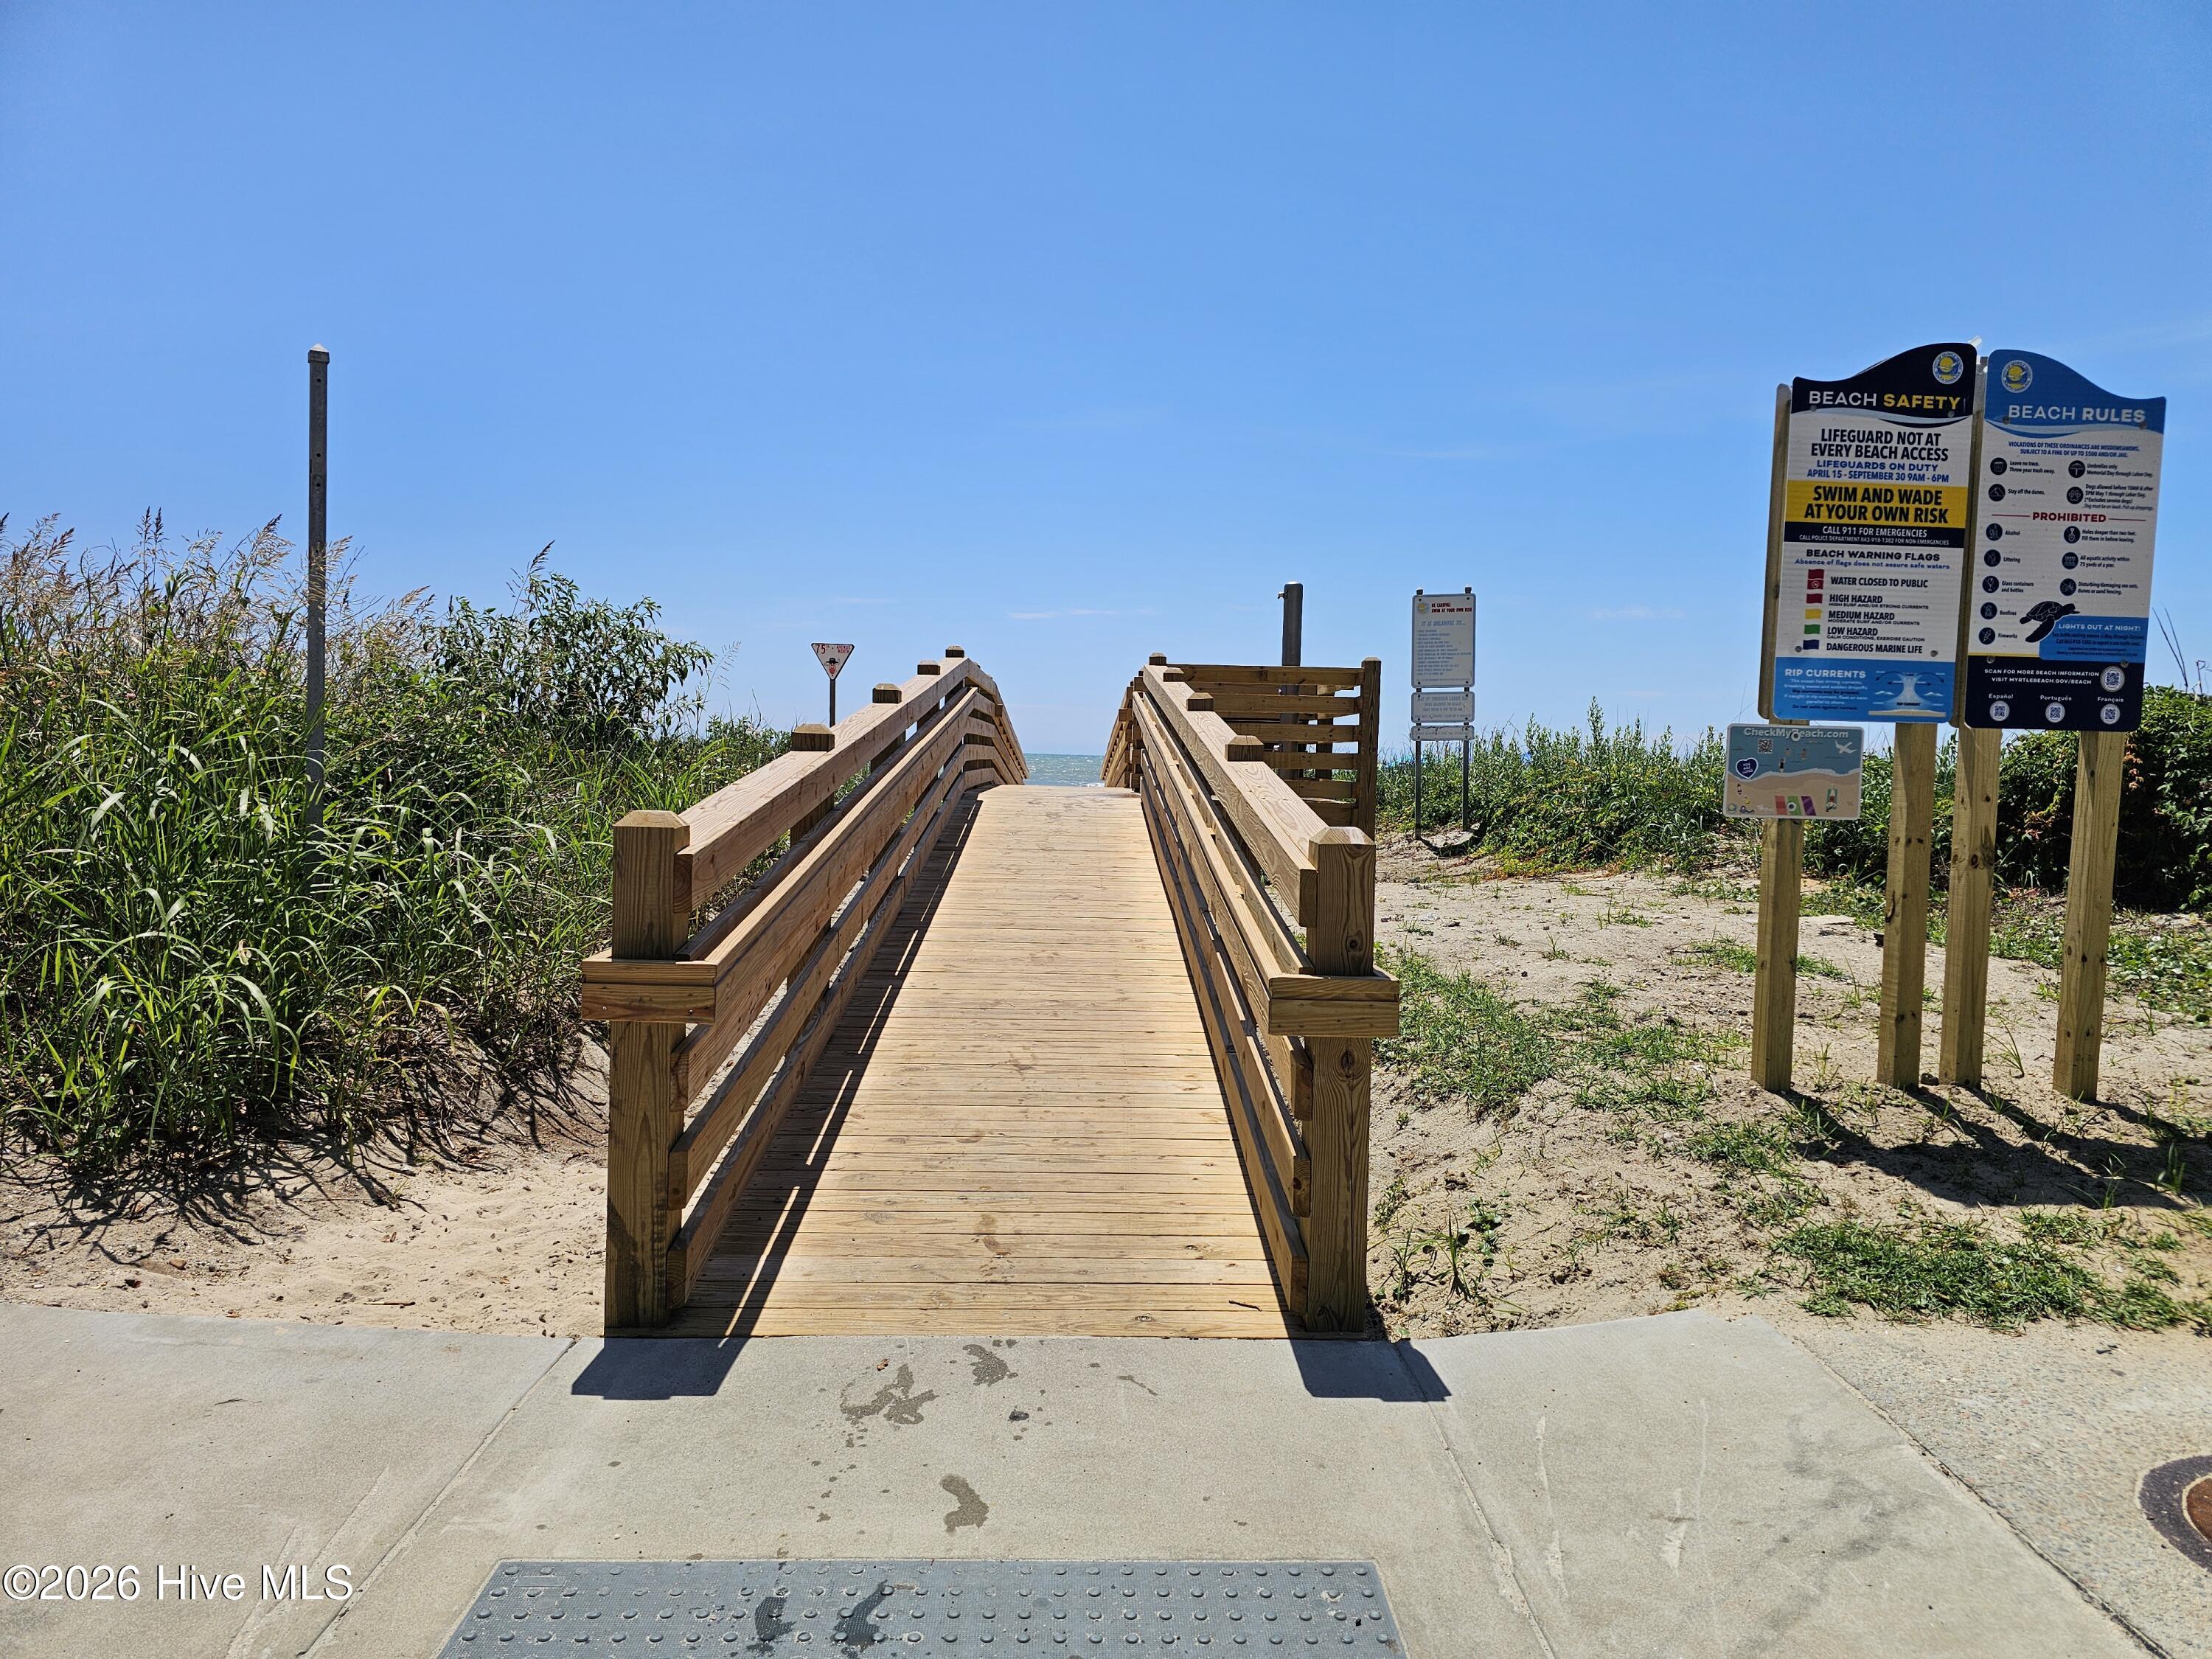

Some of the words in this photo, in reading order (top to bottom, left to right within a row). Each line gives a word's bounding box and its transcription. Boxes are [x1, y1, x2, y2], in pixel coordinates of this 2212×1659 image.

[1809, 391, 1877, 406] BEACH
[1883, 394, 1961, 410] SAFETY
[2008, 405, 2075, 420] BEACH
[2082, 408, 2146, 422] RULES
[1821, 429, 1893, 444] LIFEGUARD
[1897, 432, 1923, 445] NOT
[1925, 434, 1941, 446] AT
[1811, 444, 1852, 457] EVERY
[1855, 445, 1898, 459] BEACH
[1901, 447, 1948, 462] ACCESS
[1817, 460, 1886, 470] LIFEGUARDS
[1909, 464, 1938, 472] DUTY
[1807, 469, 1830, 478] APRIL
[1833, 470, 1842, 478] 15
[1848, 470, 1893, 480] SEPTEMBER
[1896, 473, 1905, 481] 30
[1907, 473, 1924, 481] 9AM
[1932, 474, 1949, 482] 6PM
[1813, 485, 1857, 502] SWIM
[1861, 487, 1893, 504] AND
[1898, 489, 1942, 506] WADE
[1804, 504, 1823, 518] AT
[1826, 504, 1868, 521] YOUR
[1872, 506, 1910, 522] OWN
[1914, 507, 1949, 524] RISK
[2033, 512, 2106, 522] PROHIBITED
[1823, 526, 1840, 535] CALL
[1876, 529, 1927, 538] EMERGENCIES
[1806, 549, 1844, 557] BEACH
[1848, 551, 1902, 560] WARNING
[1905, 553, 1940, 561] FLAGS
[1831, 577, 1857, 585] WATER
[1859, 577, 1888, 586] CLOSED
[1901, 580, 1928, 588] PUBLIC
[1829, 594, 1849, 602] HIGH
[1851, 595, 1882, 603] HAZARD
[1829, 611, 1862, 619] MEDIUM
[1864, 612, 1894, 620] HAZARD
[1827, 627, 1845, 635] LOW
[1847, 627, 1878, 636] HAZARD
[1826, 643, 1874, 652] DANGEROUS
[1876, 644, 1905, 653] MARINE
[1907, 645, 1922, 653] LIFE
[1806, 669, 1866, 678] CURRENTS
